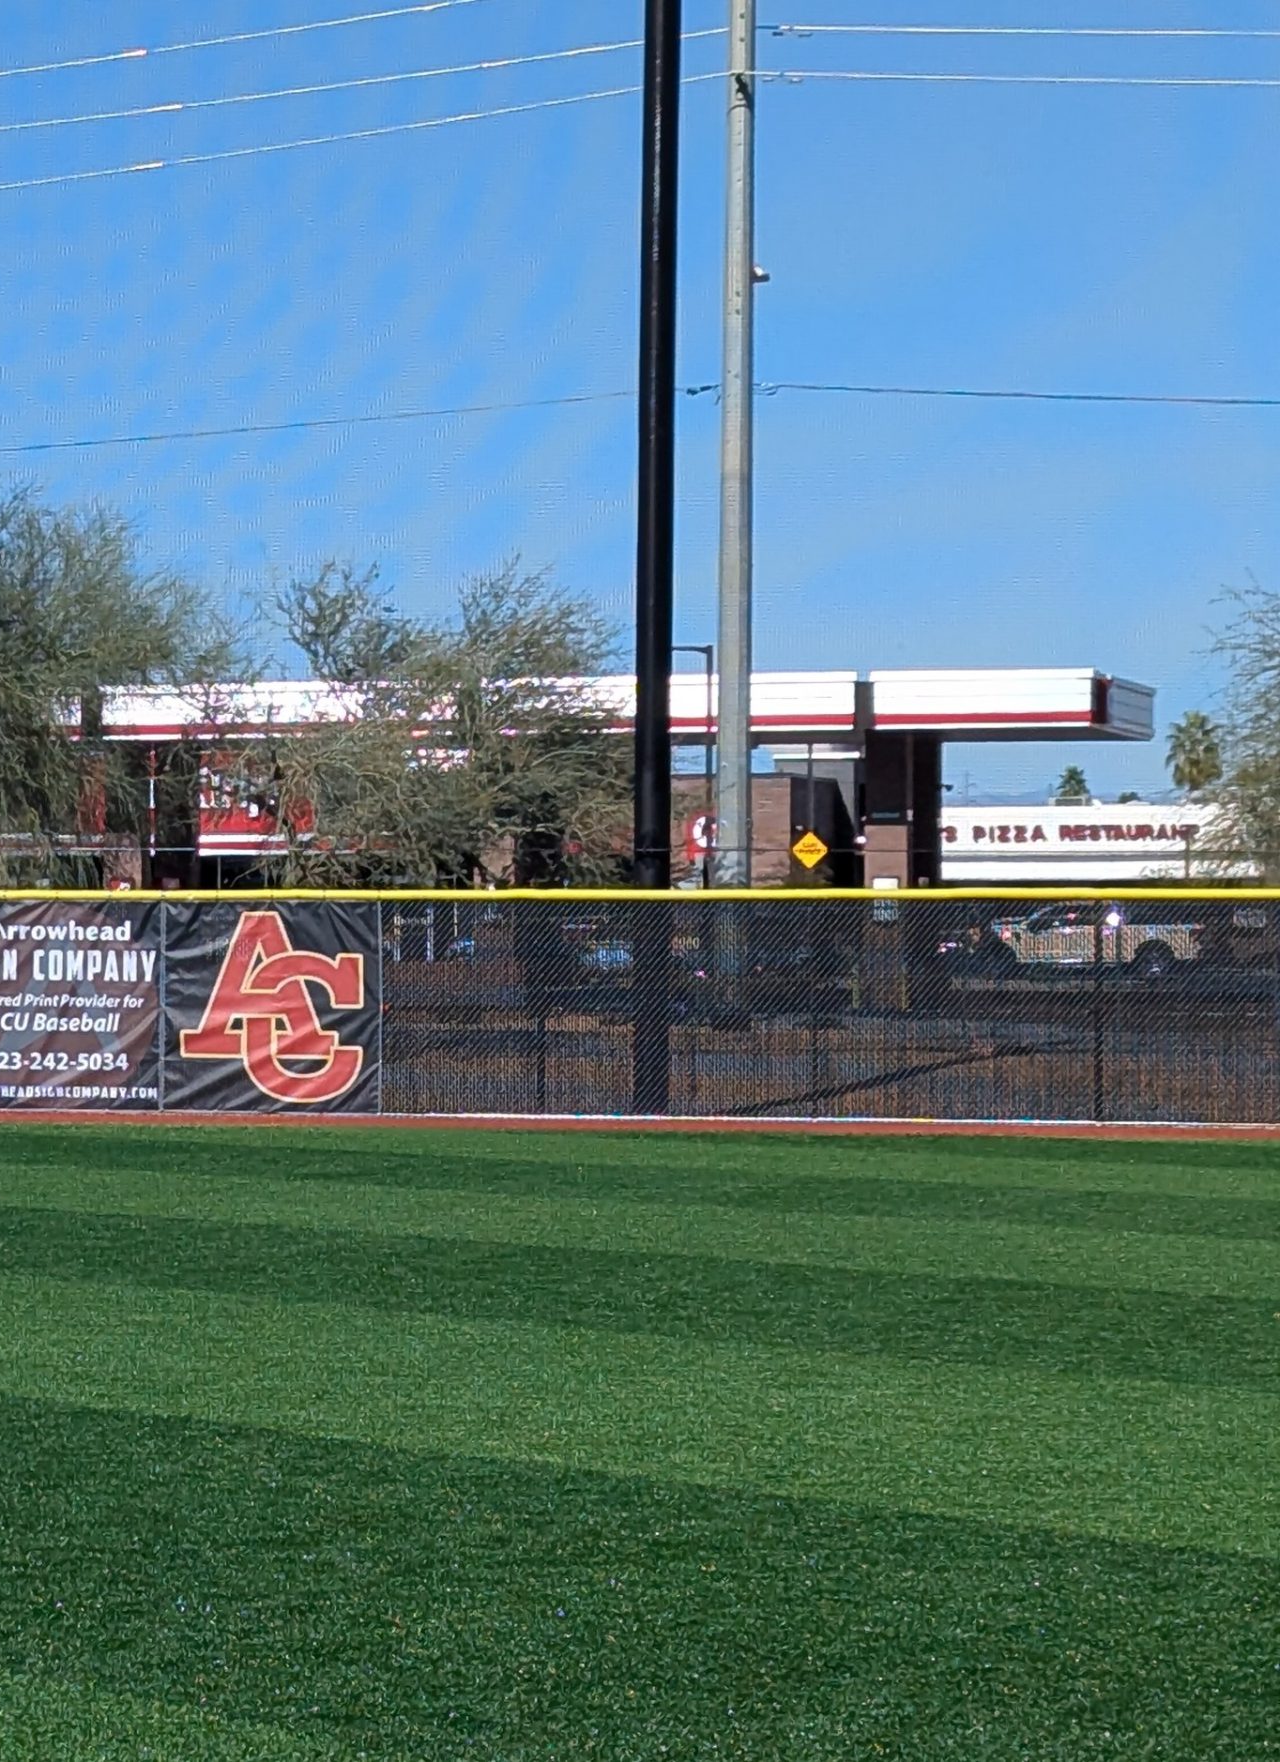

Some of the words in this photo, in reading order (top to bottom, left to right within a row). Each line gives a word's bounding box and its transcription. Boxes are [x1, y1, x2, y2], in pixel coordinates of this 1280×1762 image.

[972, 825, 1048, 843] PIZZA
[32, 949, 157, 982] COMPANY
[24, 994, 60, 1007] Print
[60, 994, 120, 1009] Provider
[122, 995, 145, 1009] for
[33, 1013, 121, 1033] Baseball
